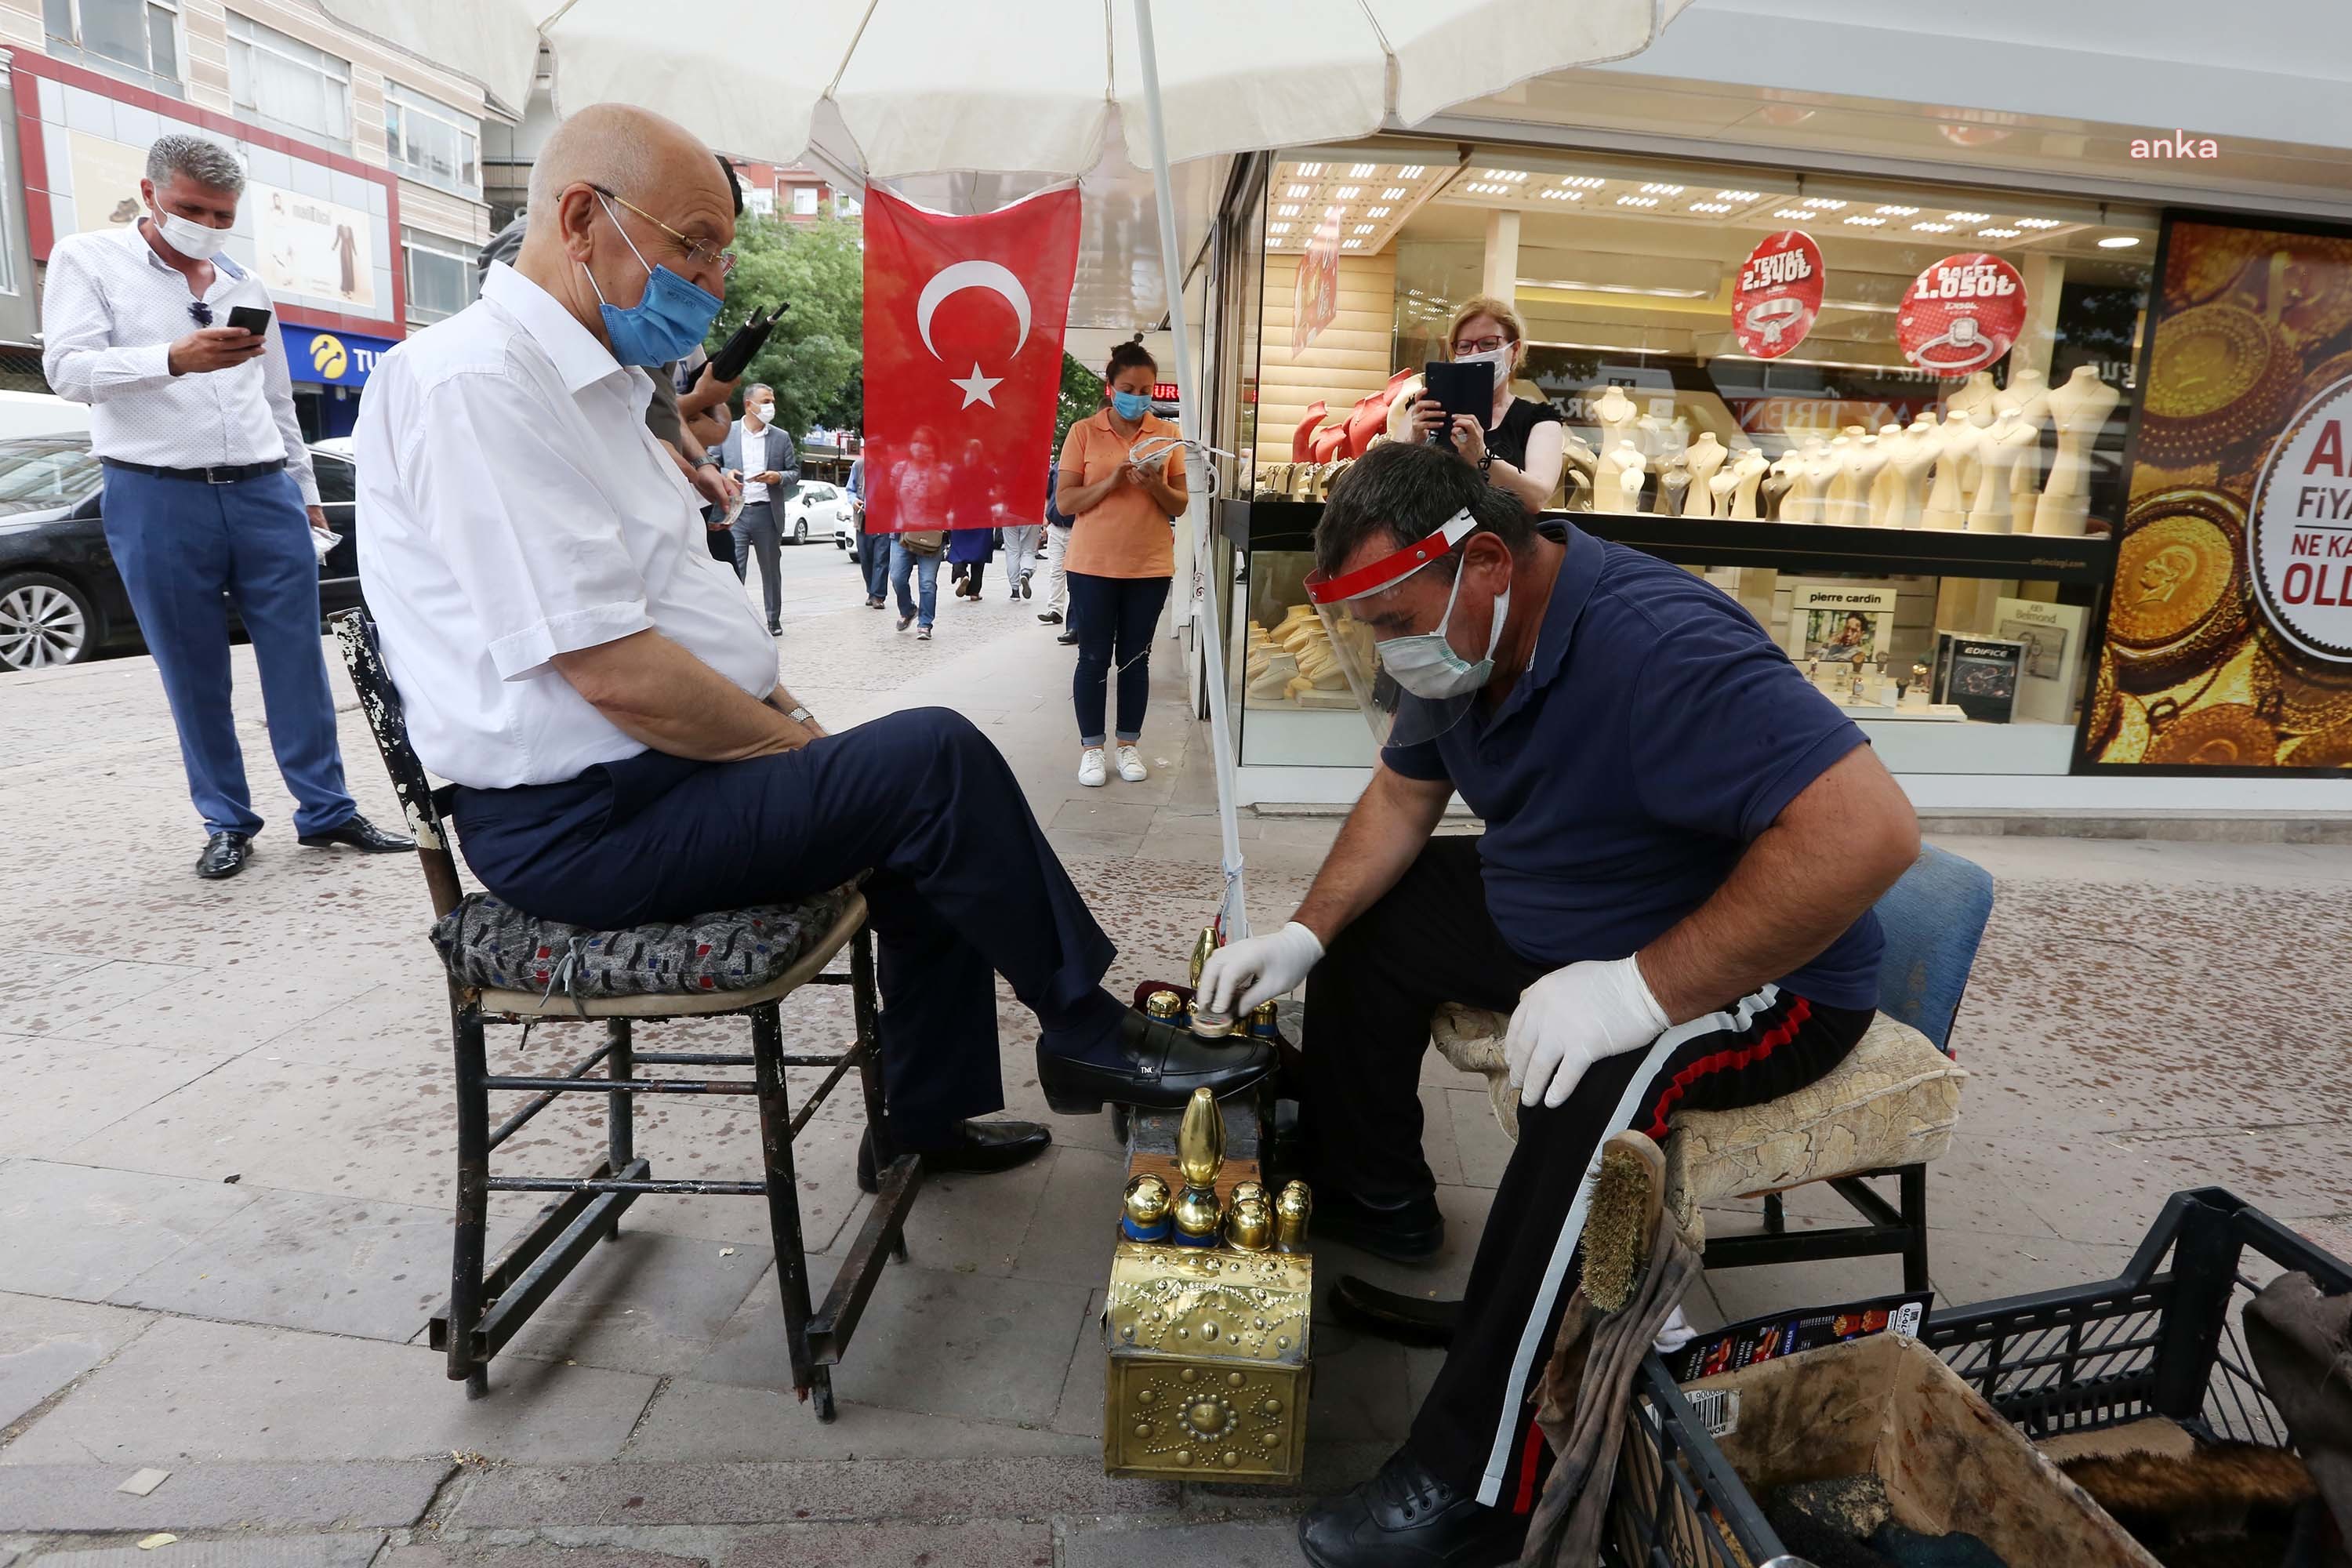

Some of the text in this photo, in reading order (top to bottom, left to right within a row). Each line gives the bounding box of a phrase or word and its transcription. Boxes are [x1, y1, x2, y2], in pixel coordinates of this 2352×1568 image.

[2303, 419, 2352, 477] A
[2291, 534, 2323, 557] NE
[1810, 593, 1882, 604] pierre cardin
[1964, 647, 2009, 658] EDIFICE
